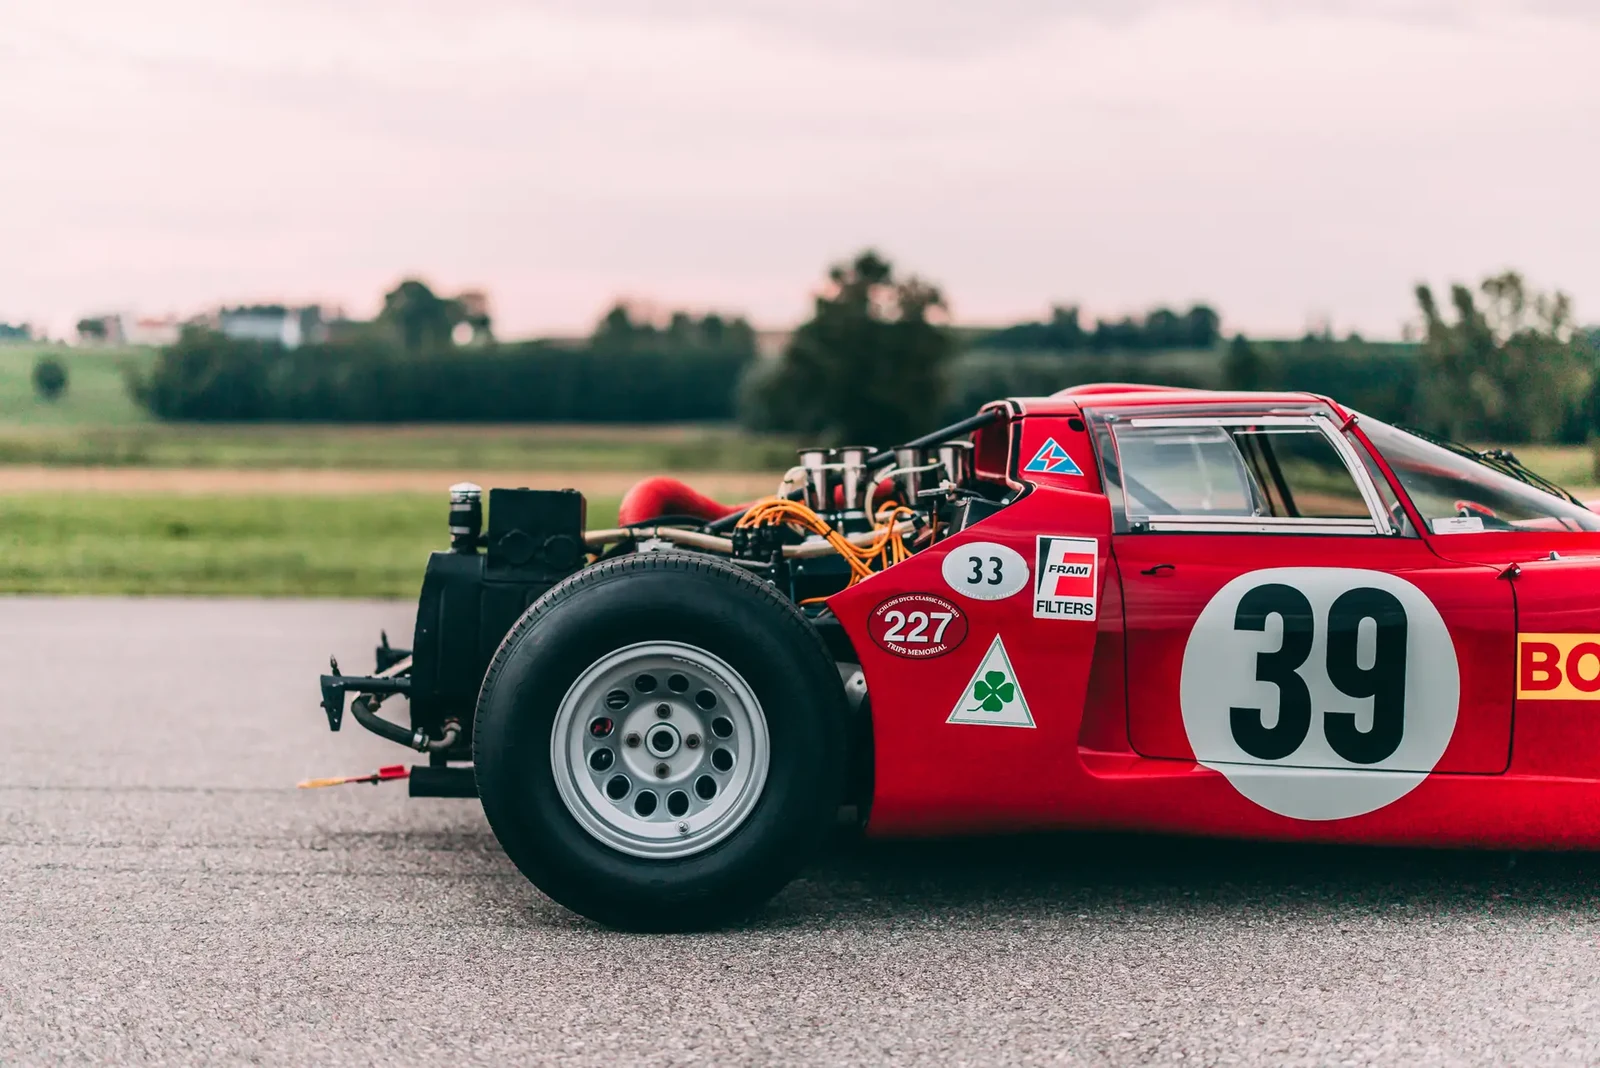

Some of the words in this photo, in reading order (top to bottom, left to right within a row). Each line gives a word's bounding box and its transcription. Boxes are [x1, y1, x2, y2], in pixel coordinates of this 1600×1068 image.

[967, 556, 1003, 585] 33
[1048, 564, 1089, 575] FRAM
[876, 598, 899, 616] SCHLOSS
[914, 595, 938, 604] CLASSIC
[937, 599, 951, 610] DAYS
[1036, 600, 1094, 616] FILTERS
[883, 610, 953, 643] 227
[886, 641, 907, 654] TRIPS
[907, 643, 948, 656] MEMORIAL
[1229, 583, 1408, 765] 39
[1520, 642, 1600, 692] BO
